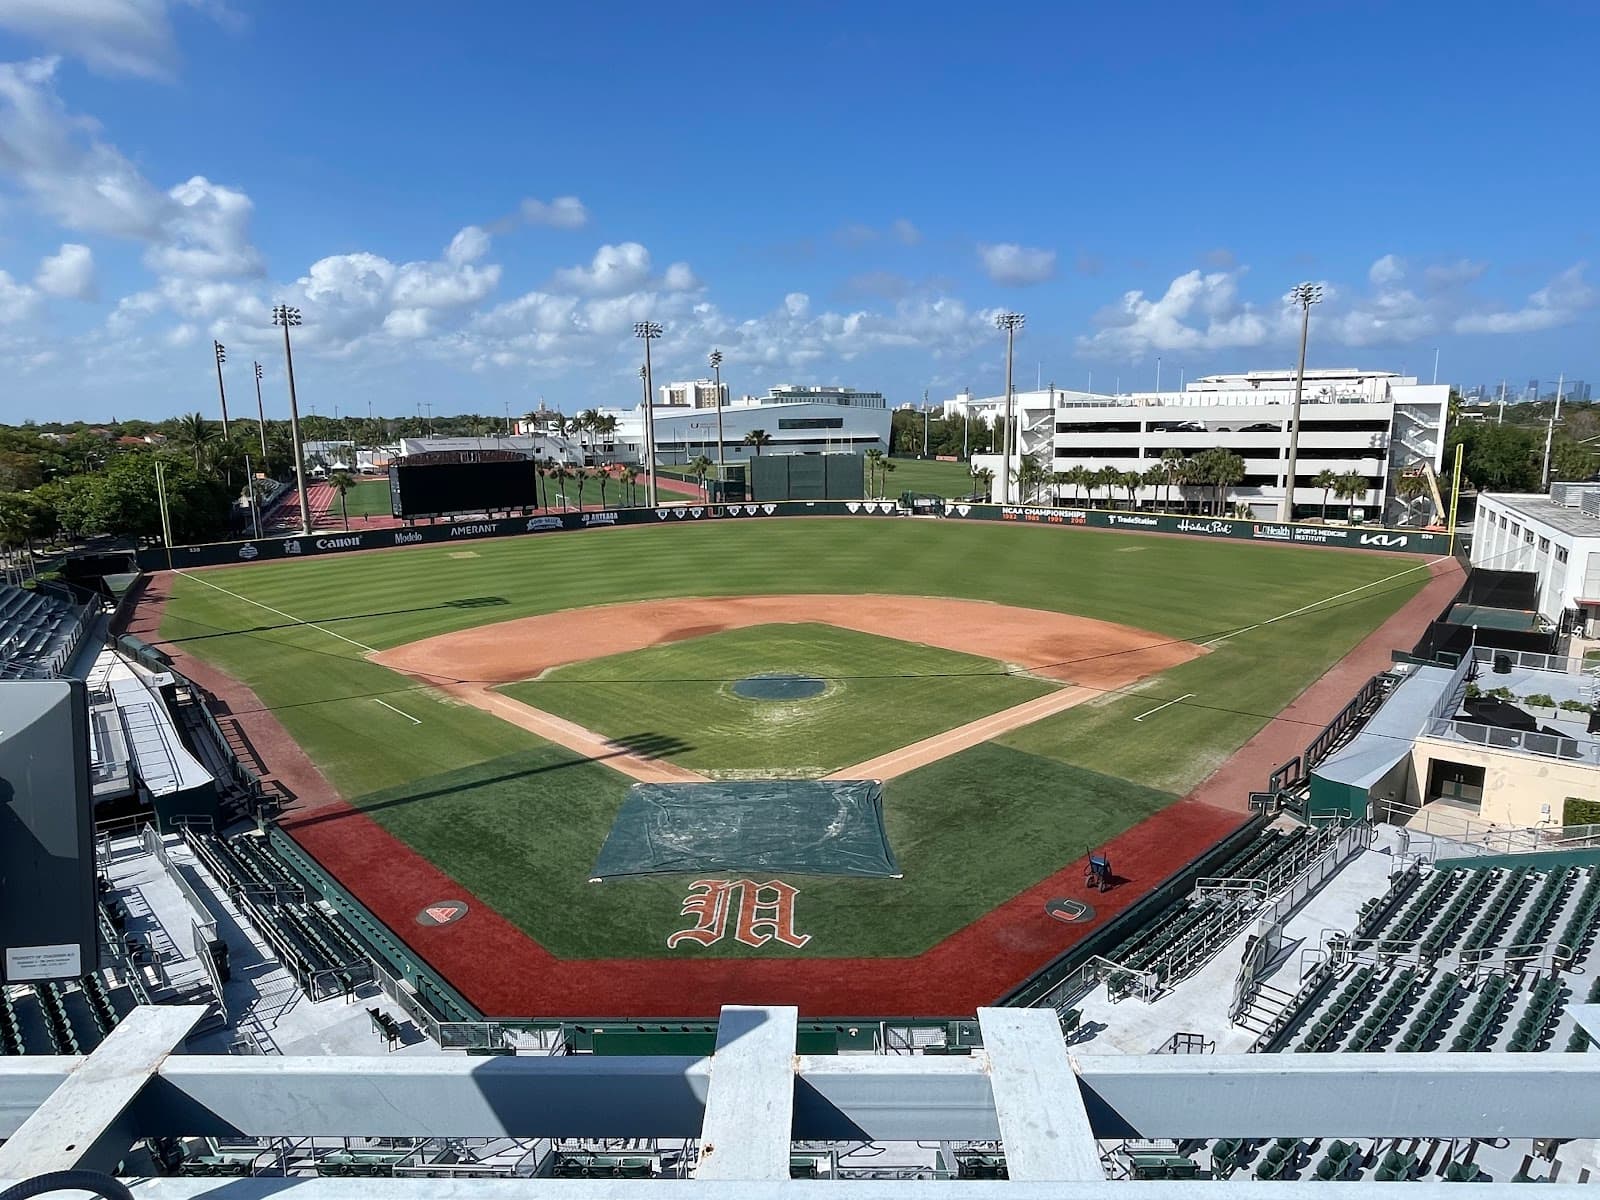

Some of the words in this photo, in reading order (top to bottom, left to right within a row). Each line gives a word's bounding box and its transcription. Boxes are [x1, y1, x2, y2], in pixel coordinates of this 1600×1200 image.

[1002, 507, 1023, 515] NCAA
[1024, 508, 1086, 518] CHAMPIONSHIPS
[1117, 515, 1158, 526] TradeStation
[450, 523, 497, 536] AMERANT
[1211, 520, 1232, 534] Park
[1295, 527, 1317, 535] SPORTS
[1318, 529, 1348, 538] MEDICINE
[316, 536, 361, 550] Canon
[395, 532, 423, 545] Modelo
[1295, 534, 1327, 542] INSTITUTE
